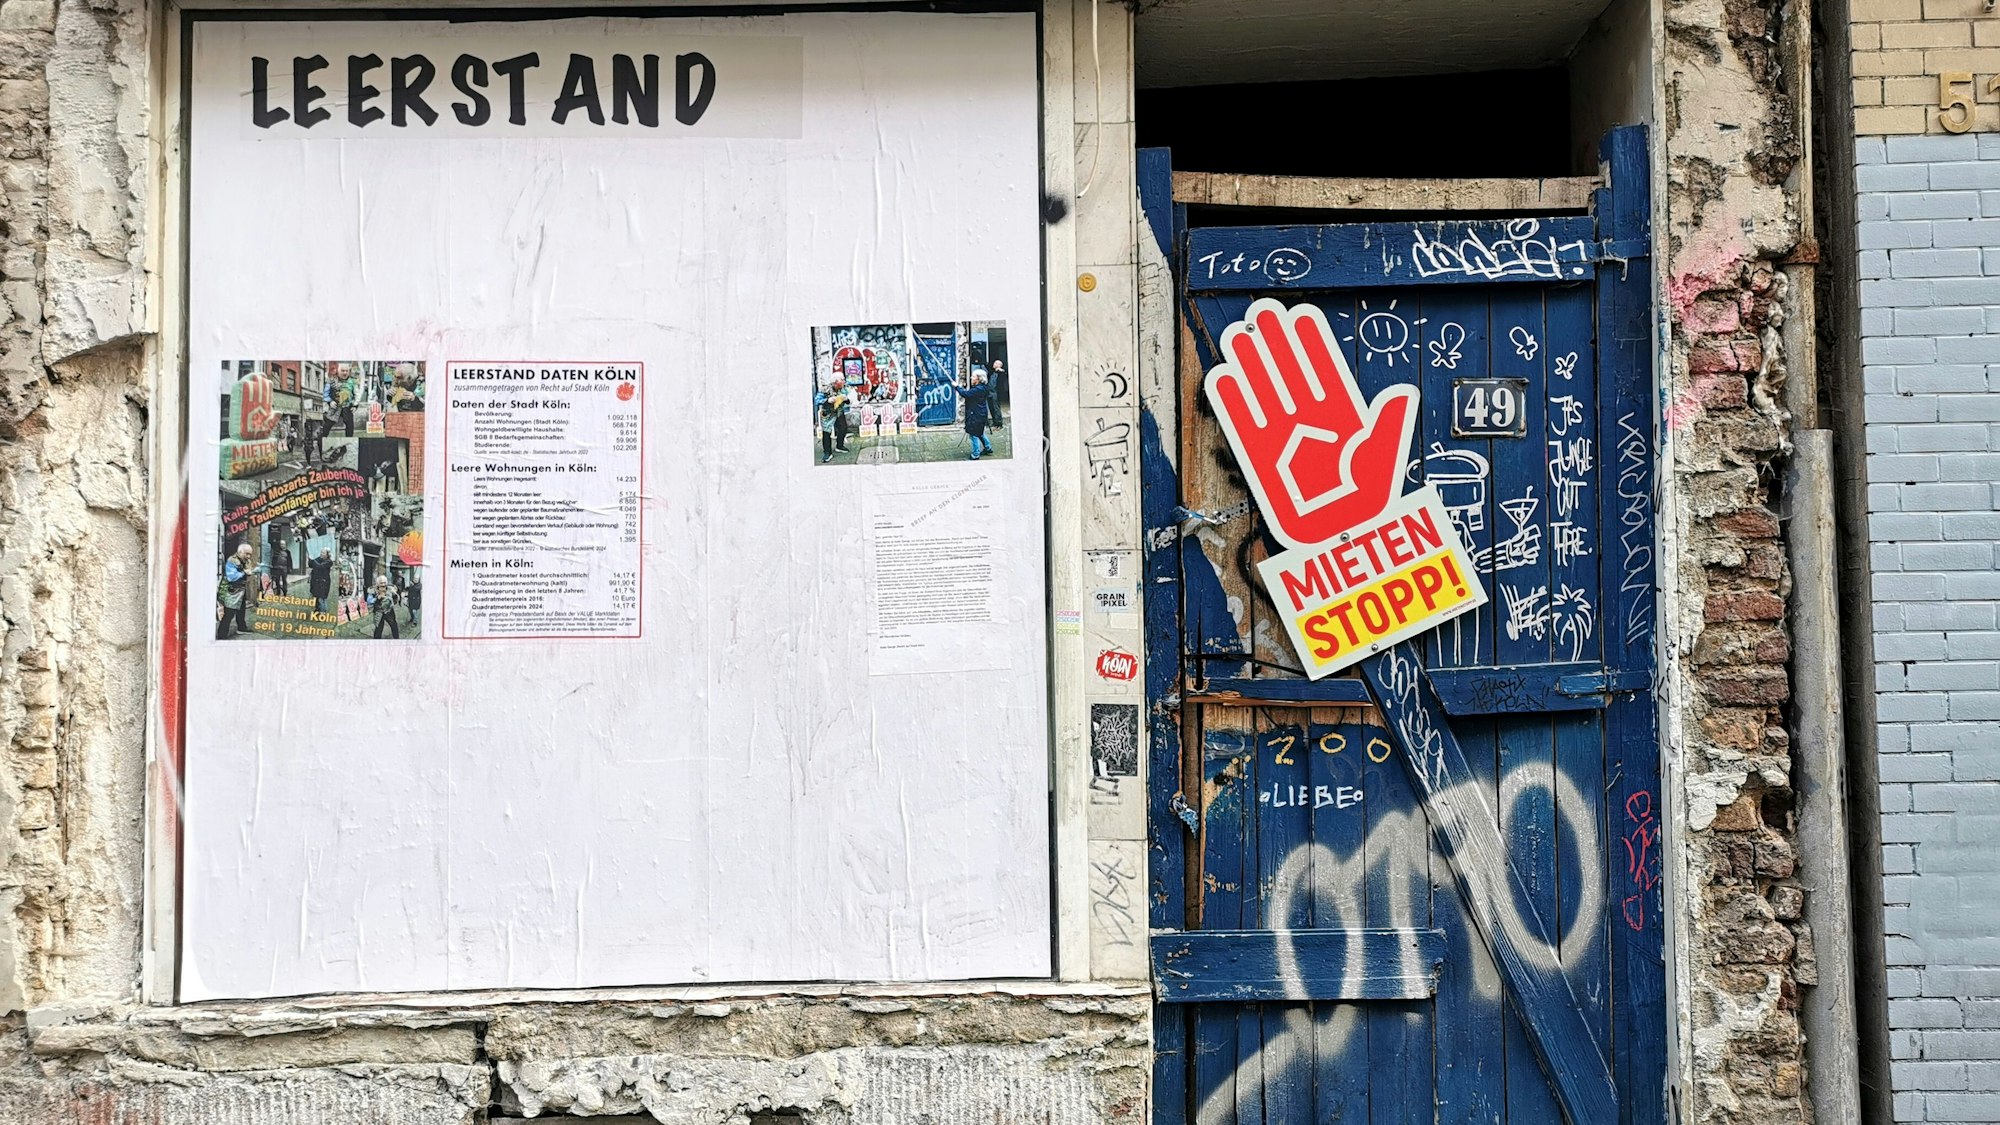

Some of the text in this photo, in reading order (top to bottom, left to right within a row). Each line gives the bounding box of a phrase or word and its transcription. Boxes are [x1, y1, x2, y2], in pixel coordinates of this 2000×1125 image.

[250, 51, 716, 129] LEERSTAND
[1939, 71, 2000, 134] 5
[454, 366, 636, 380] LEERSTAND DATEN KÖLN
[454, 385, 524, 393] zusammengetragen
[540, 384, 560, 392] Recht
[561, 384, 573, 392] auf
[574, 384, 592, 392] Stadt
[593, 384, 610, 392] Köln
[453, 400, 570, 409] Daten der Stadt Köln:
[1464, 387, 1516, 429] 49
[452, 463, 597, 474] Leere Wohnungen in Köln:
[250, 494, 267, 510] mit
[268, 475, 308, 501] Mozarts
[308, 469, 365, 485] Zauberflöte
[250, 491, 318, 526] Taubenfänger
[319, 486, 336, 499] bin
[337, 486, 353, 497] ich
[450, 559, 533, 568] Mieten in Köln:
[1280, 506, 1444, 611] MIETEN
[258, 591, 317, 607] Leerstand
[1096, 593, 1125, 601] GRAIN
[1304, 555, 1467, 658] STOPP!
[256, 607, 337, 623] mitten in Köln
[254, 621, 335, 637] seit 19 Jahren
